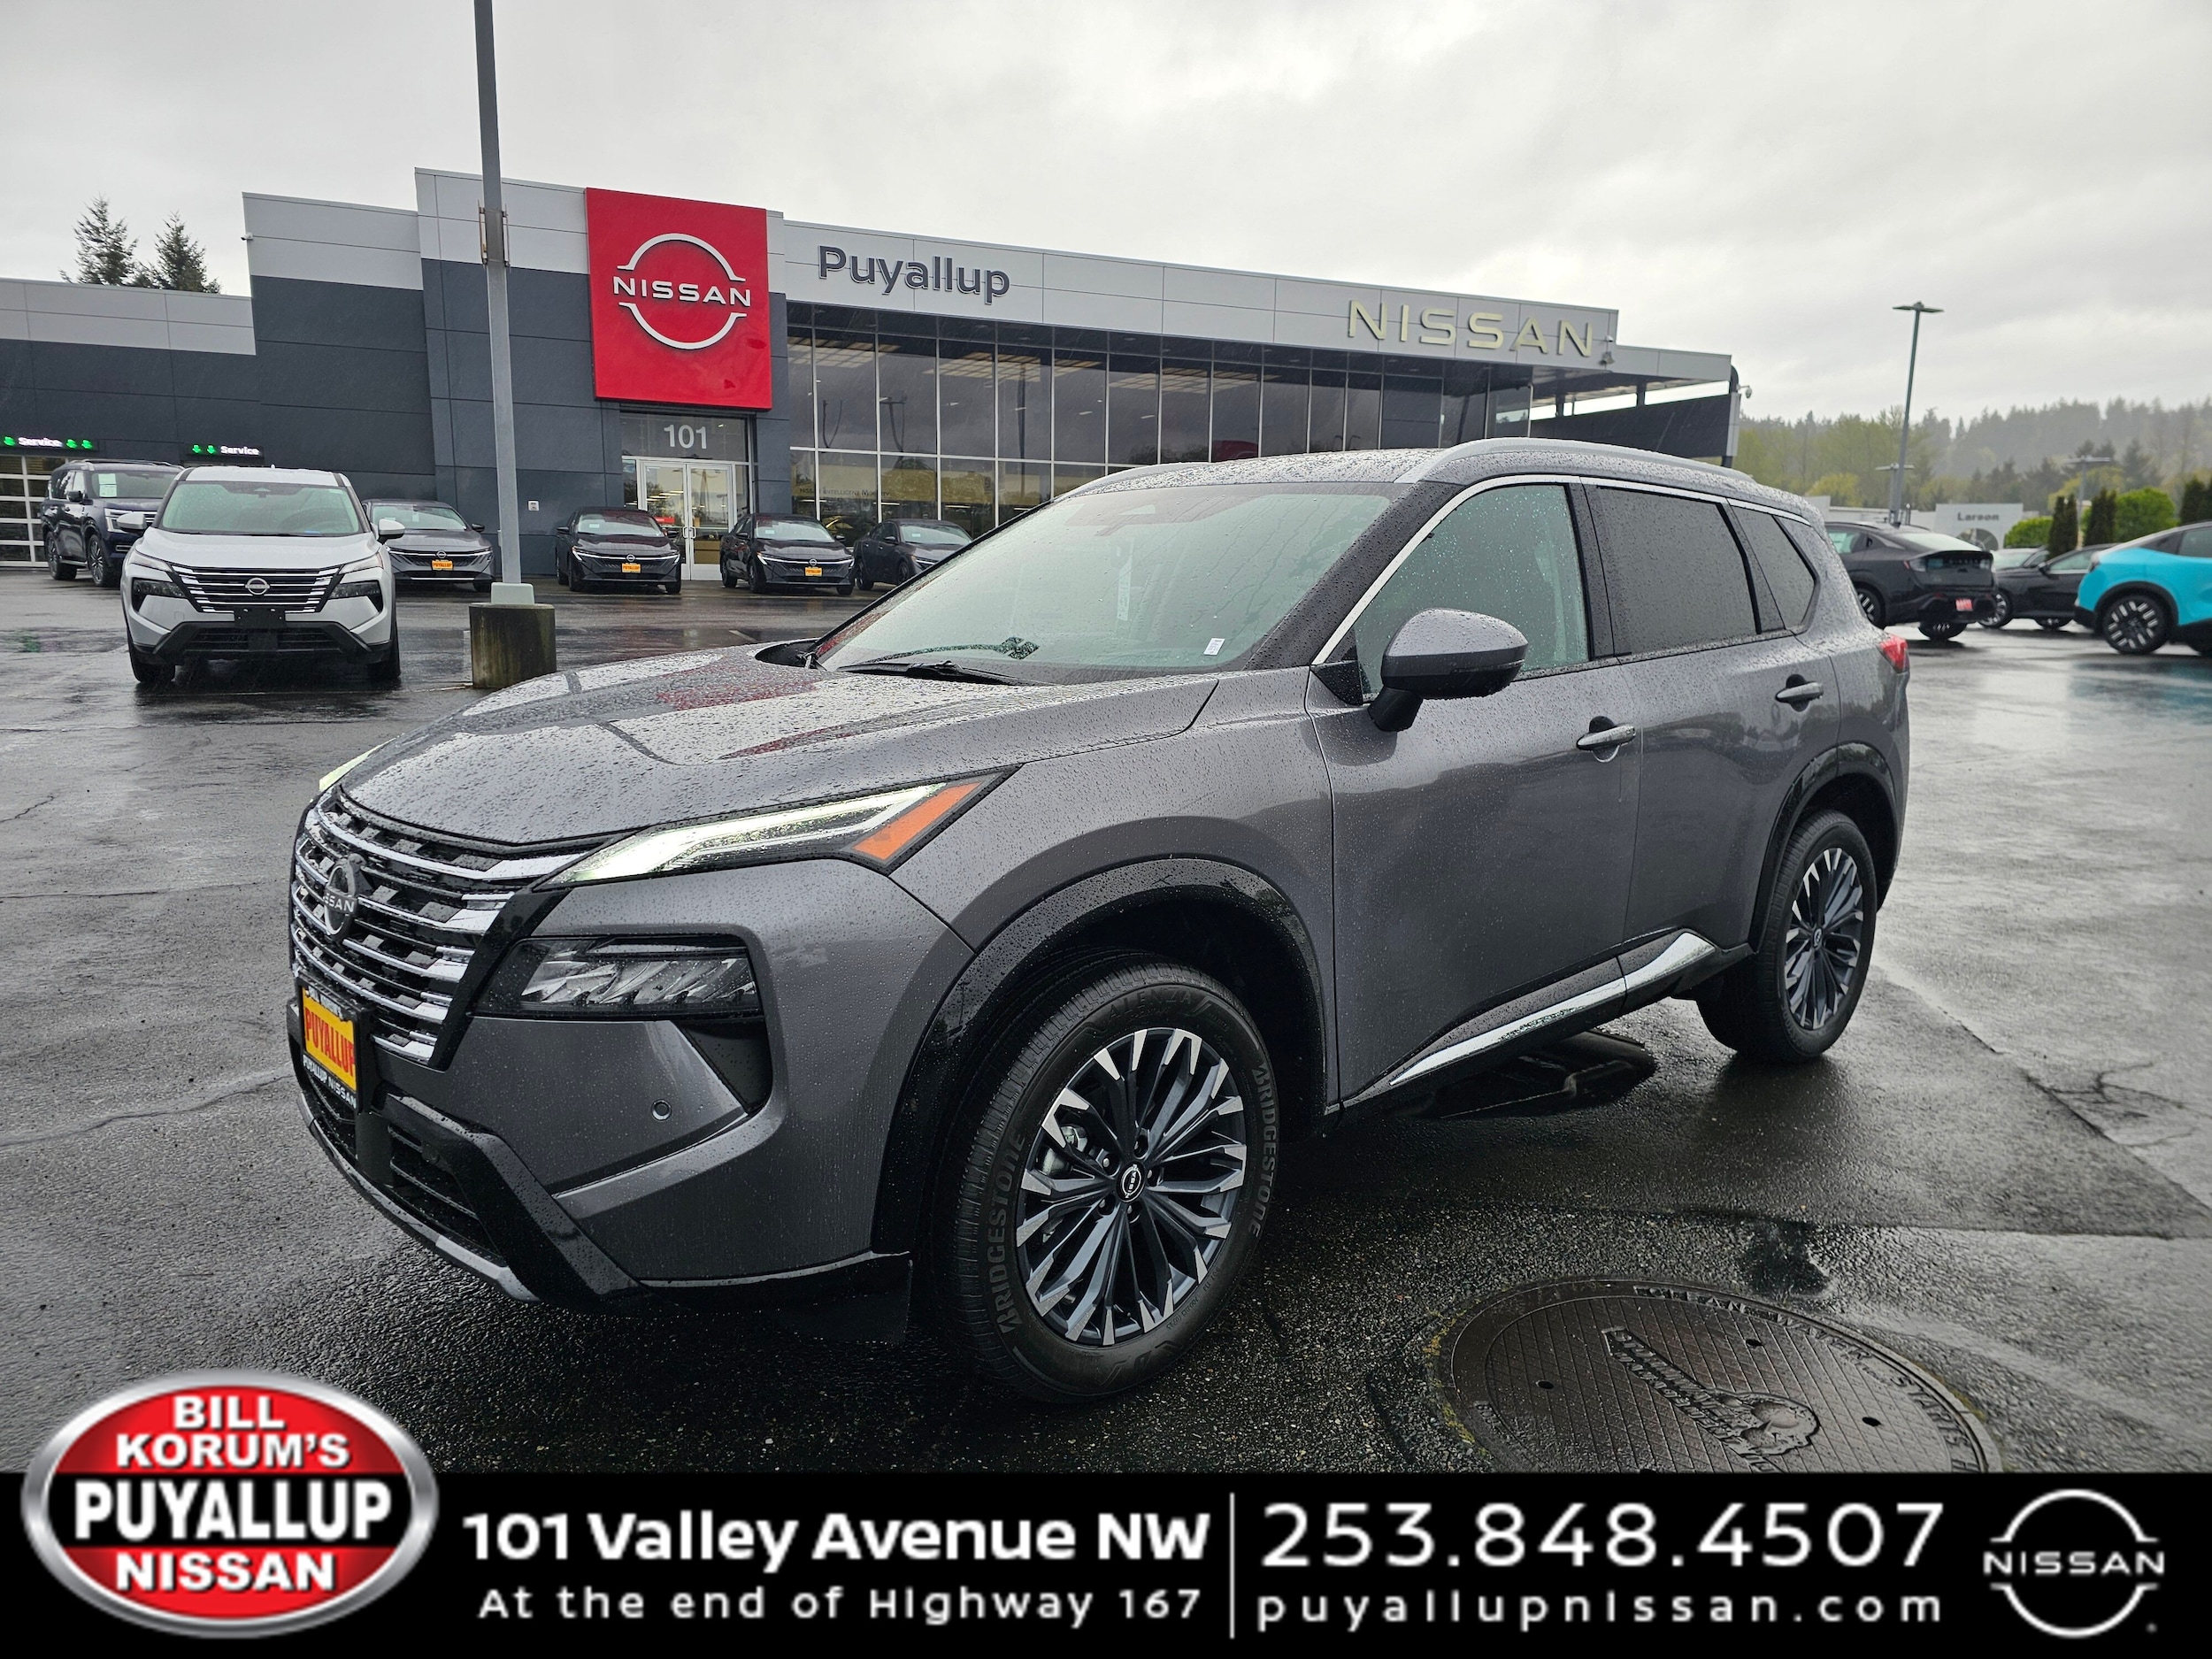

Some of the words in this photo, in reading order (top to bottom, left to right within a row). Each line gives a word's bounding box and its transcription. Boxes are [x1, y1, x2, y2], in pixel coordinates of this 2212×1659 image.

[612, 275, 752, 308] NISSAN
[818, 244, 1011, 304] Puyallup
[1348, 299, 1594, 357] NISSAN
[18, 436, 64, 448] Service
[219, 445, 260, 456] Service
[663, 424, 709, 450] 101
[1957, 511, 2000, 521] Larson
[304, 1006, 356, 1077] PUYALLUP
[327, 1075, 357, 1109] NISSAN
[1248, 1062, 1277, 1238] BRIDGESTONE
[987, 1129, 1025, 1333] BRIDGESTONE
[1888, 1376, 1973, 1448] STARTS
